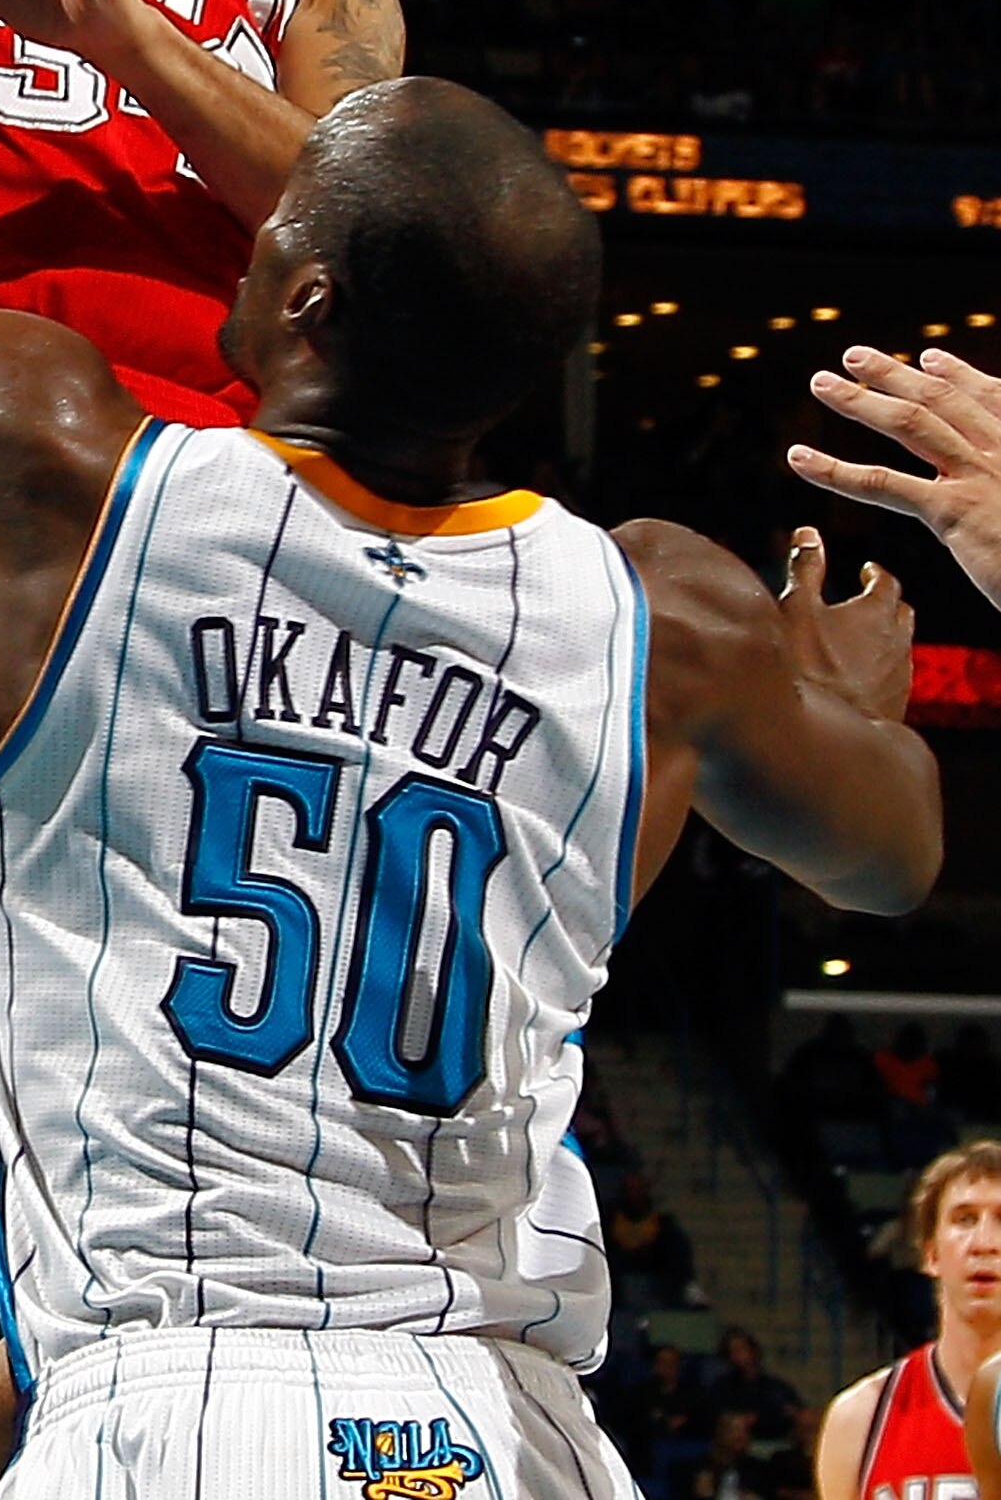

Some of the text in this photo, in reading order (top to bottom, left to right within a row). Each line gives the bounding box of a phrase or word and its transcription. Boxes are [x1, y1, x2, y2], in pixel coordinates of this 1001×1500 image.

[191, 615, 540, 798] OKAFOR
[159, 736, 508, 1119] 50
[327, 1417, 485, 1482] NOLA
